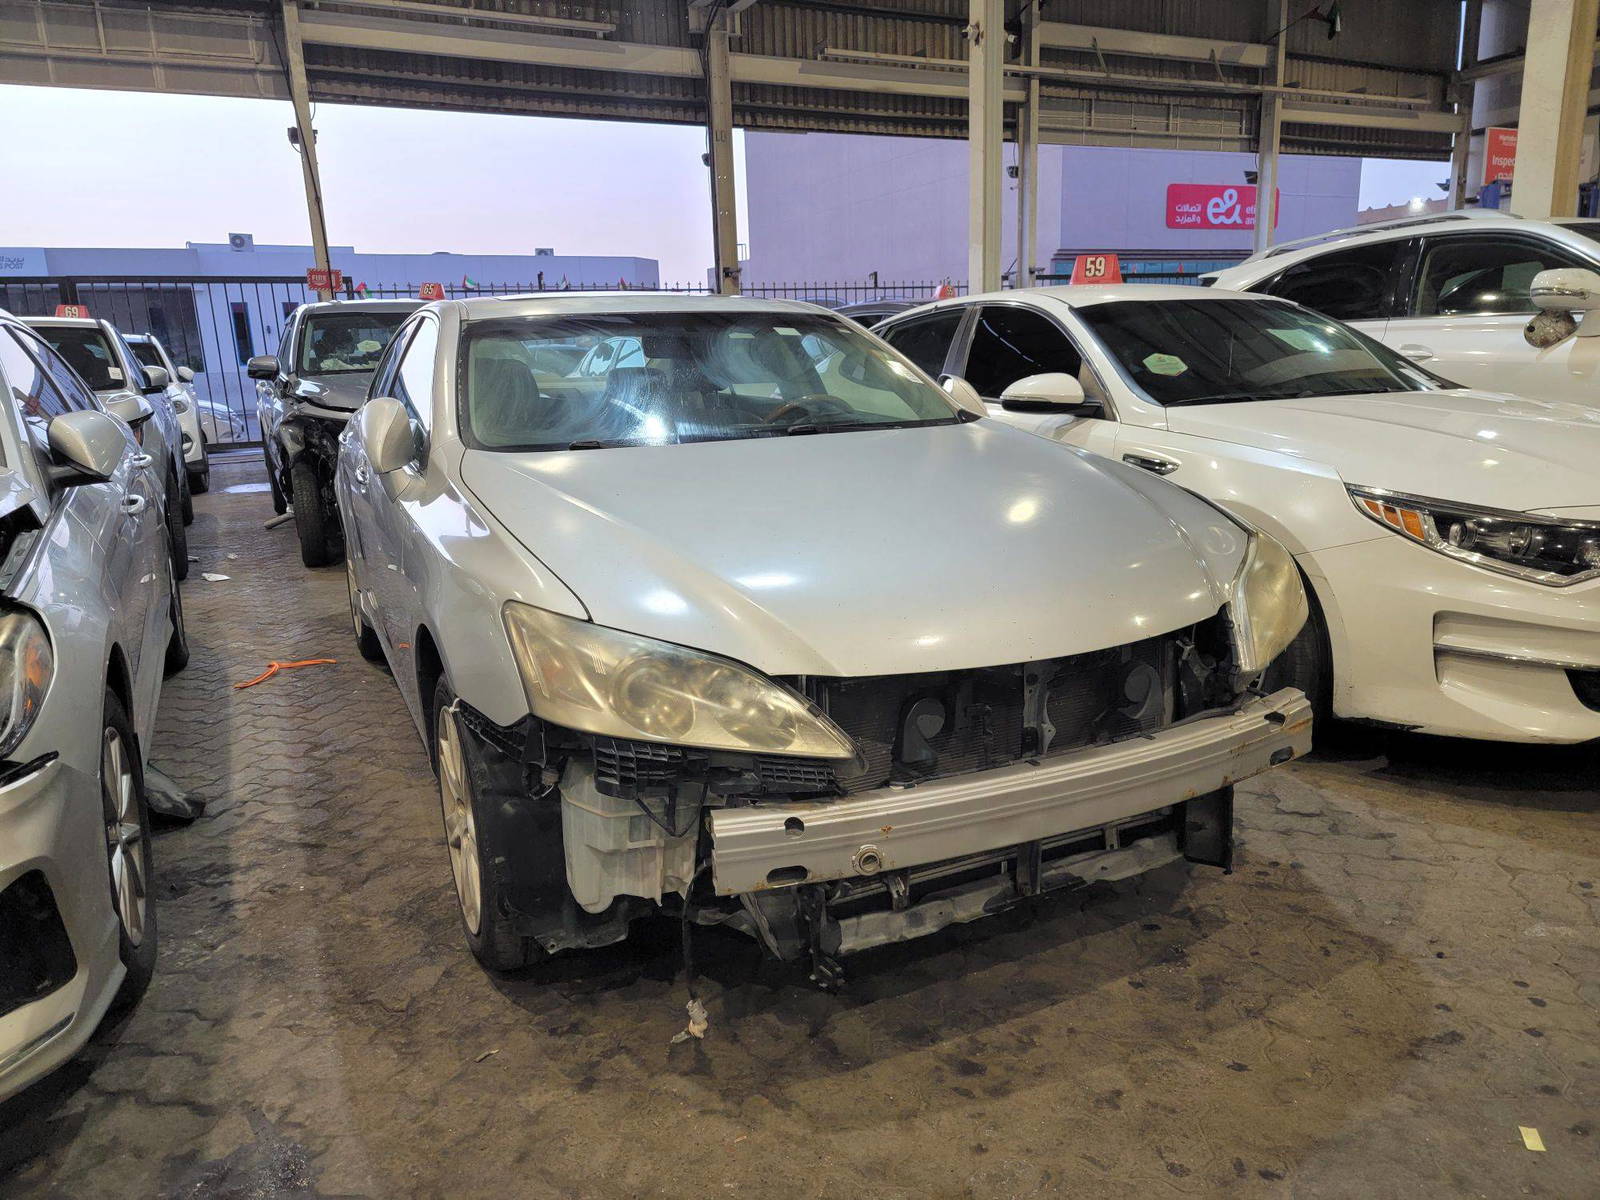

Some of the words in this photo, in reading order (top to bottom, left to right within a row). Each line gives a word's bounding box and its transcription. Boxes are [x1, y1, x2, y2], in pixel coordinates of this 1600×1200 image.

[1085, 256, 1106, 277] 59
[423, 283, 434, 296] 65
[64, 306, 79, 318] 69
